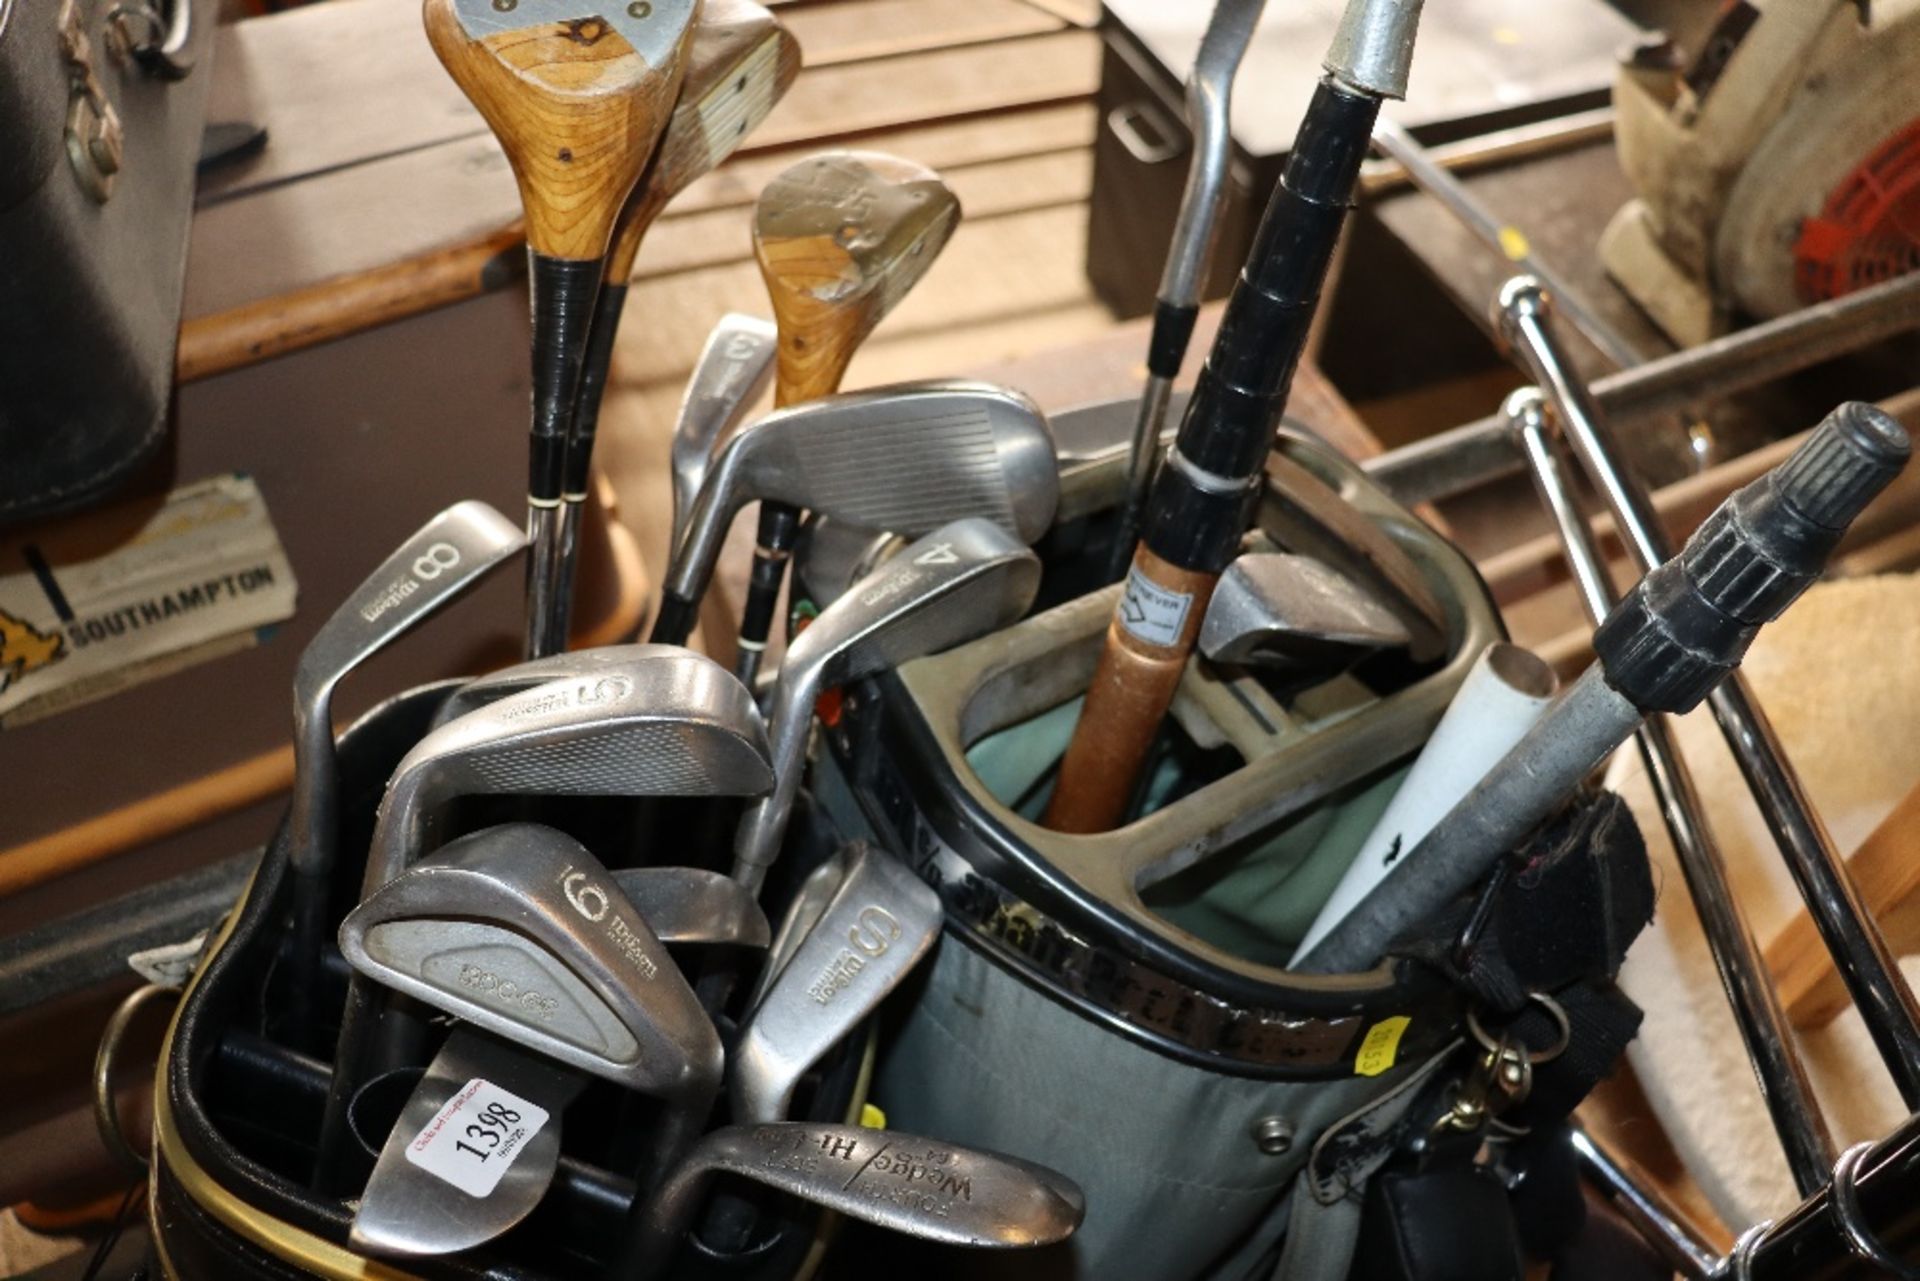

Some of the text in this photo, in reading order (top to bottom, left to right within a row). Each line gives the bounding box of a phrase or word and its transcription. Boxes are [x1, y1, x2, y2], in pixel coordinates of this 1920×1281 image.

[412, 542, 461, 581] 8
[913, 541, 960, 565] 4
[67, 561, 275, 649] SOUTHAMPTON
[577, 674, 632, 706] 5
[455, 1101, 522, 1164] 1398
[873, 1151, 971, 1202] Wedge
